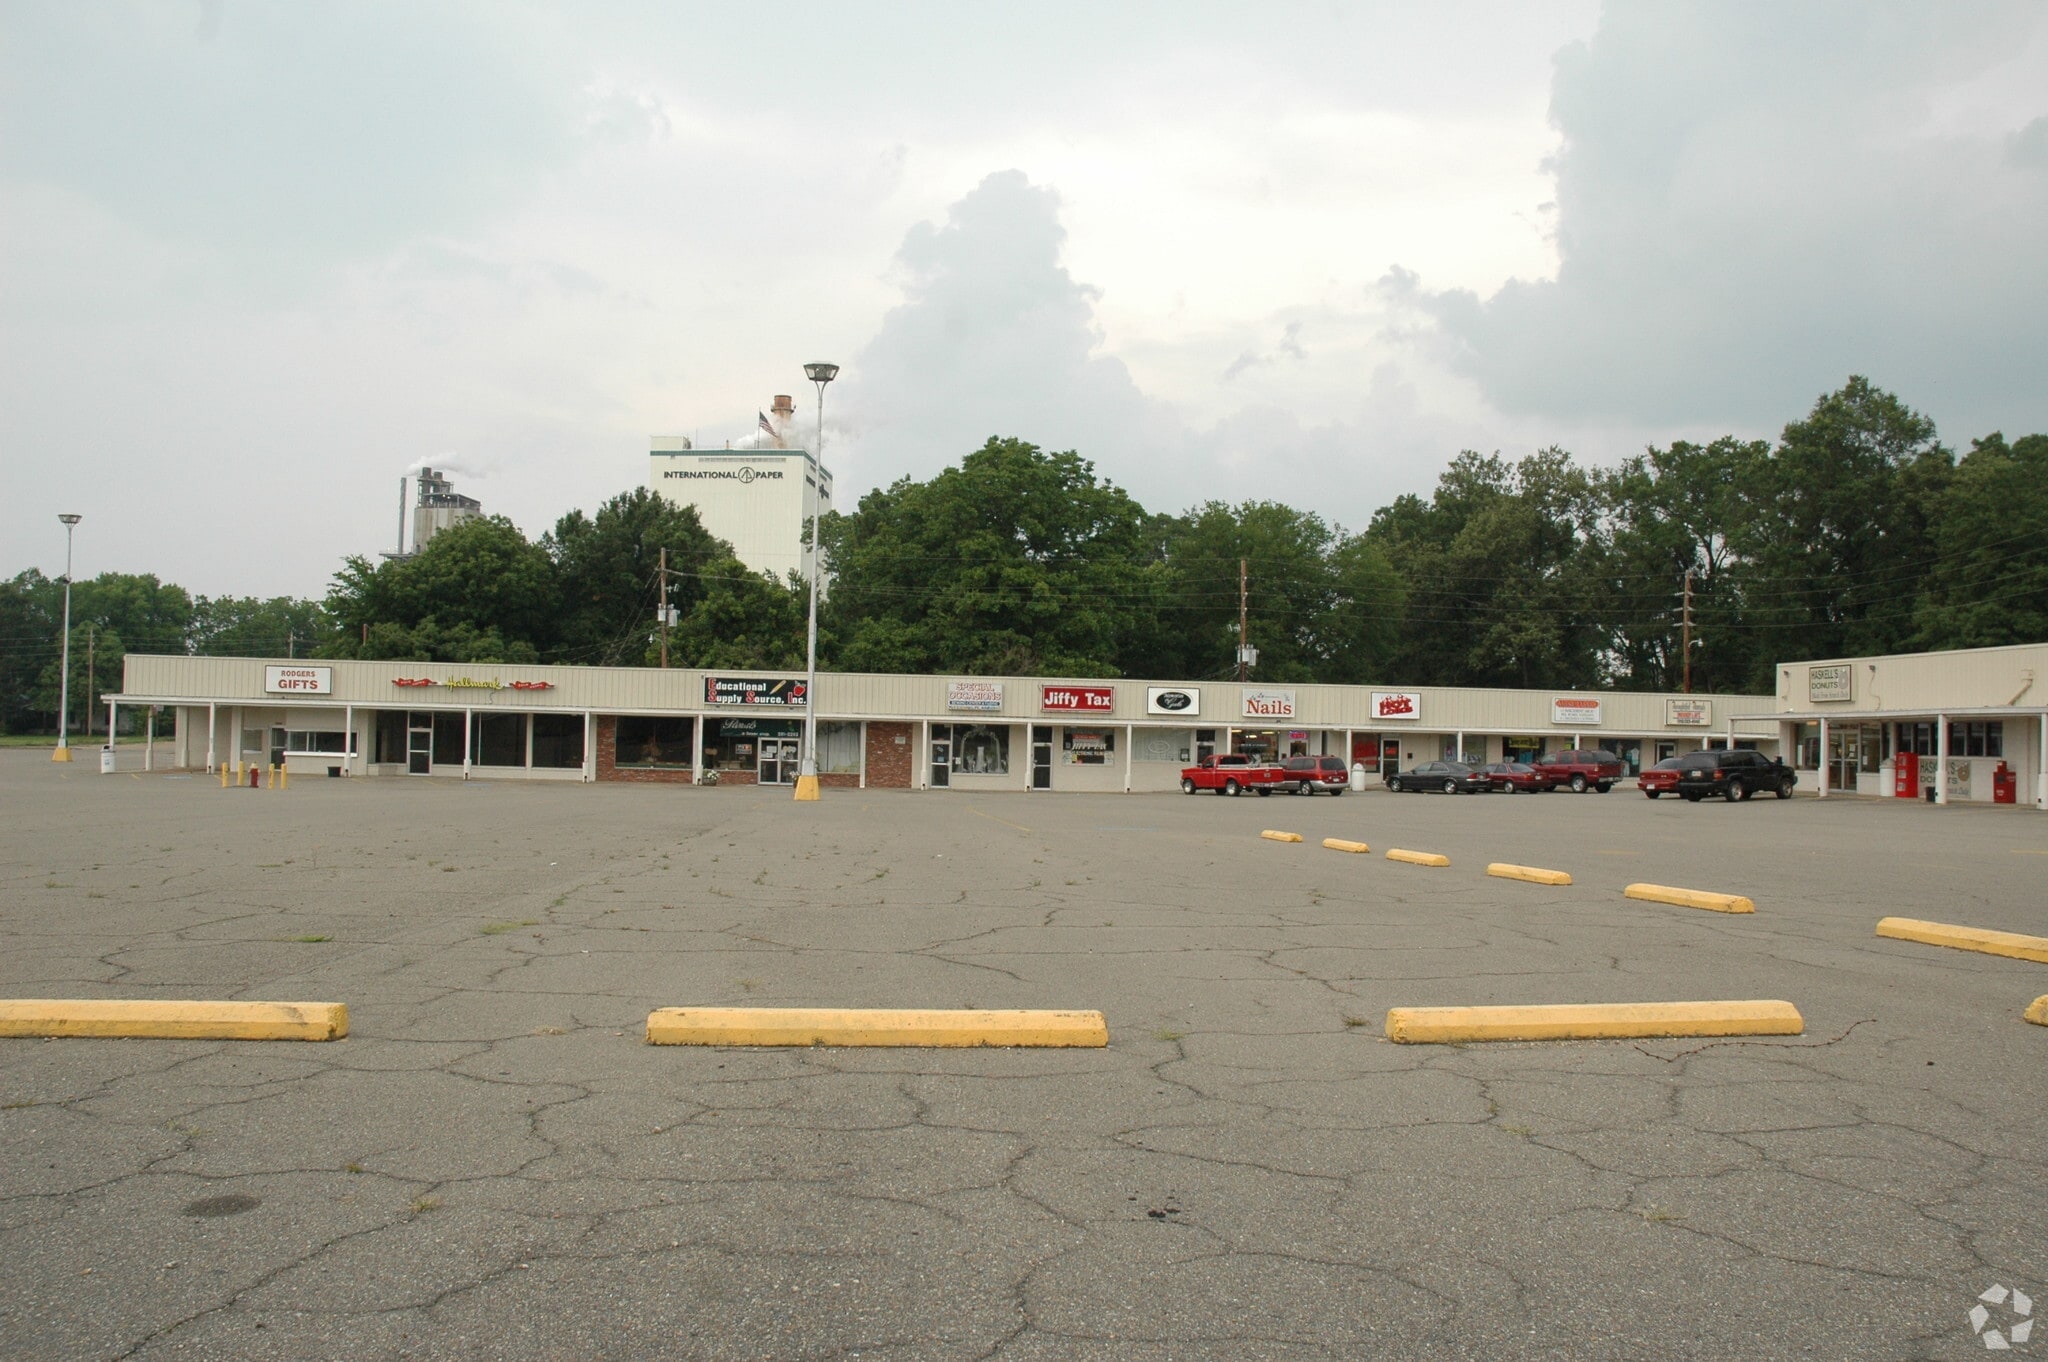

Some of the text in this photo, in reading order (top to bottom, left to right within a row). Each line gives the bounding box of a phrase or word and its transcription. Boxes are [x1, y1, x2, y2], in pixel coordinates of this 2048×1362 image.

[664, 470, 783, 479] INTERNATIONAL PAPER
[278, 679, 318, 690] GIFTS
[446, 675, 504, 692] Hallmark
[708, 678, 766, 691] Educational
[956, 683, 994, 692] SPECIAL
[1811, 682, 1838, 690] DONUTS
[708, 689, 807, 704] Supply Source, Inc.
[950, 692, 1001, 701] OCCASIONS
[1045, 691, 1111, 708] Jiffy Tax
[1246, 699, 1292, 715] Nails
